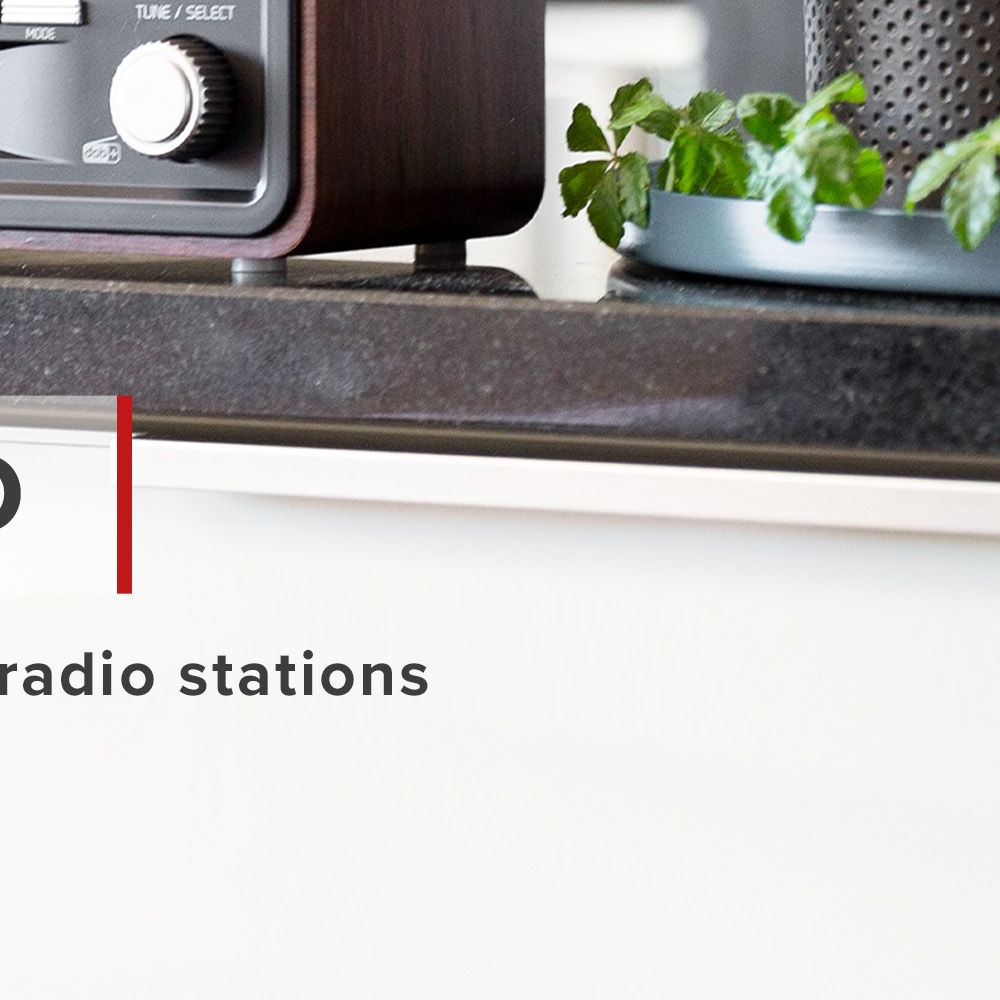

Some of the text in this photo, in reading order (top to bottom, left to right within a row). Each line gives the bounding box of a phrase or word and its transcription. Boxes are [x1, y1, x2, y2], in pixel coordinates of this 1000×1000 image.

[136, 4, 171, 20] TUNE
[185, 4, 237, 21] SELECT
[24, 27, 57, 41] MODE
